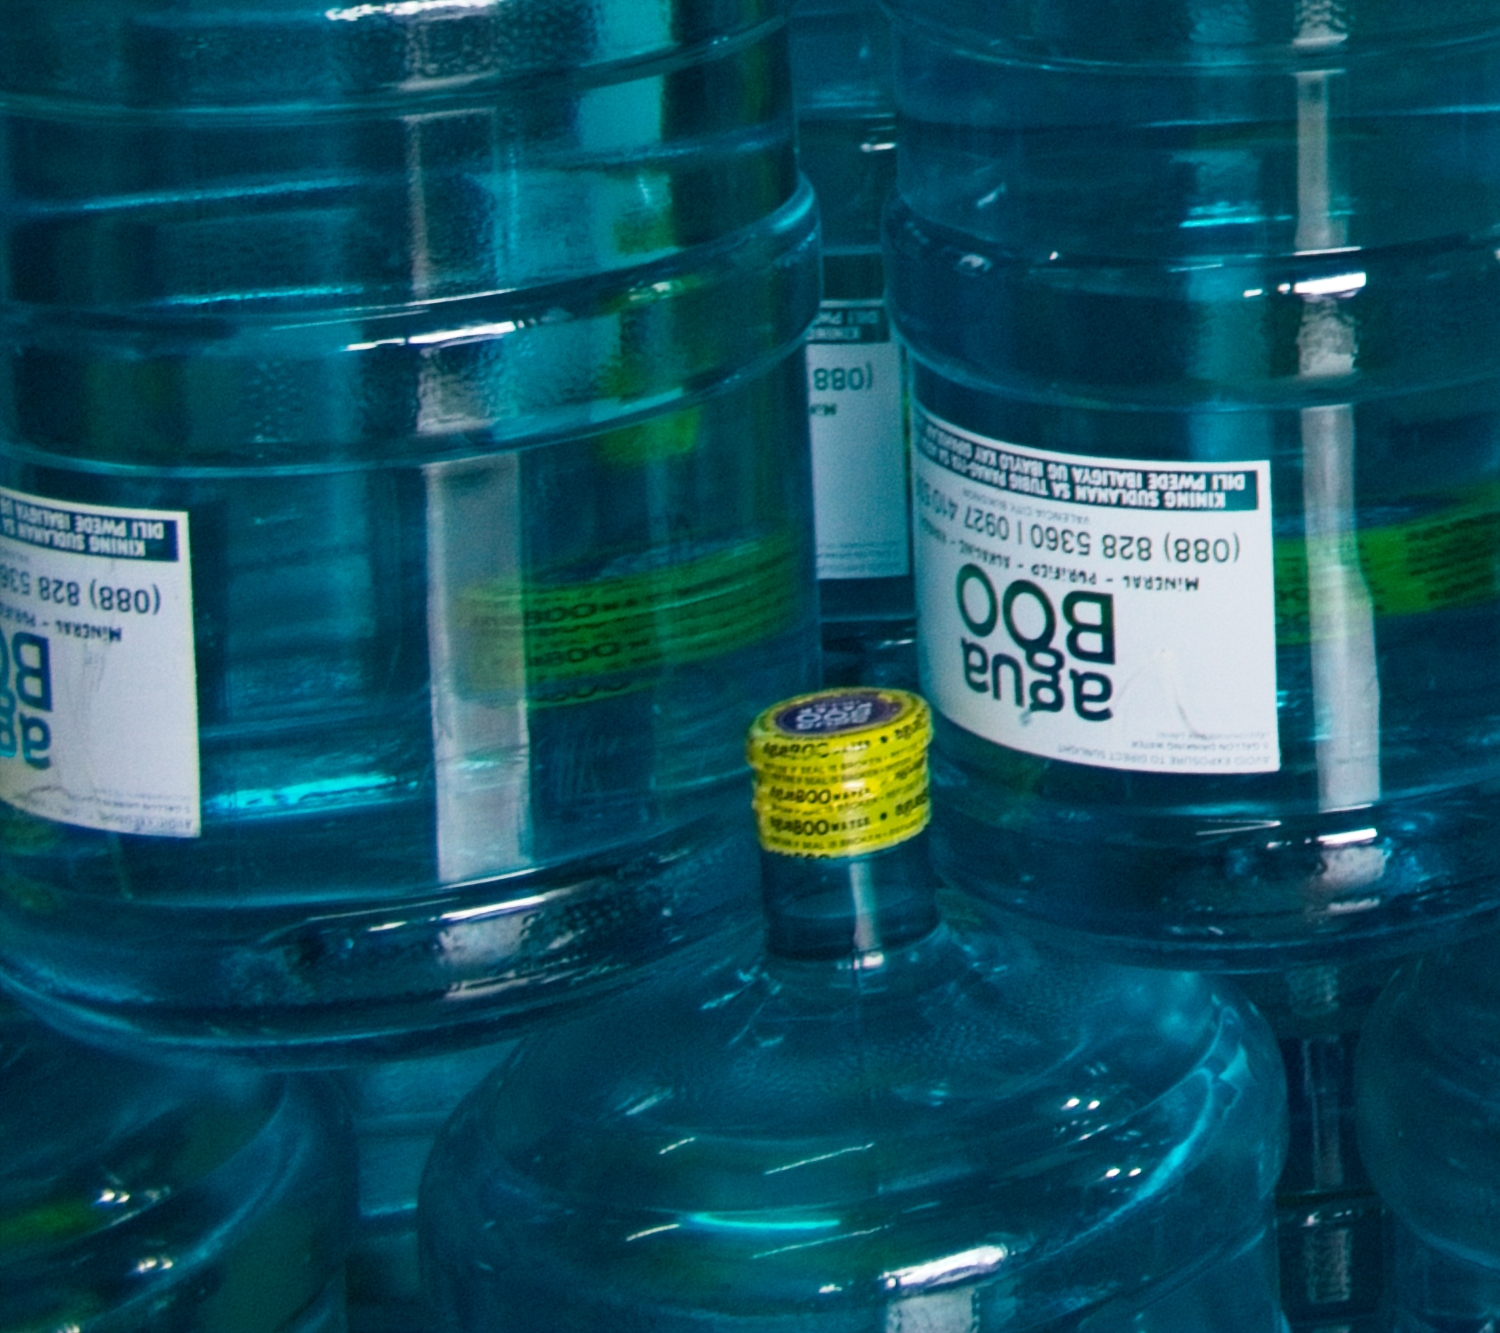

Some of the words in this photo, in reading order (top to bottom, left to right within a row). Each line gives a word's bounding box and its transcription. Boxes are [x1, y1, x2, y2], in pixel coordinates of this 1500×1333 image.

[1046, 463, 1069, 481] UG
[1070, 466, 1143, 490] IBALIGYA
[1147, 472, 1207, 491] PWEDE
[1211, 473, 1246, 491] DILI
[1049, 482, 1072, 500] SA
[1074, 484, 1160, 508] SUDLANAN
[1164, 491, 1226, 508] KINING
[963, 506, 1011, 541] 0927
[1030, 524, 1092, 557] 5360
[1101, 534, 1153, 562] 828
[1163, 532, 1241, 564] (088)
[38, 576, 81, 607] 828
[88, 579, 162, 615] (088)
[956, 563, 1117, 666] BOO
[960, 638, 1114, 724] agua
